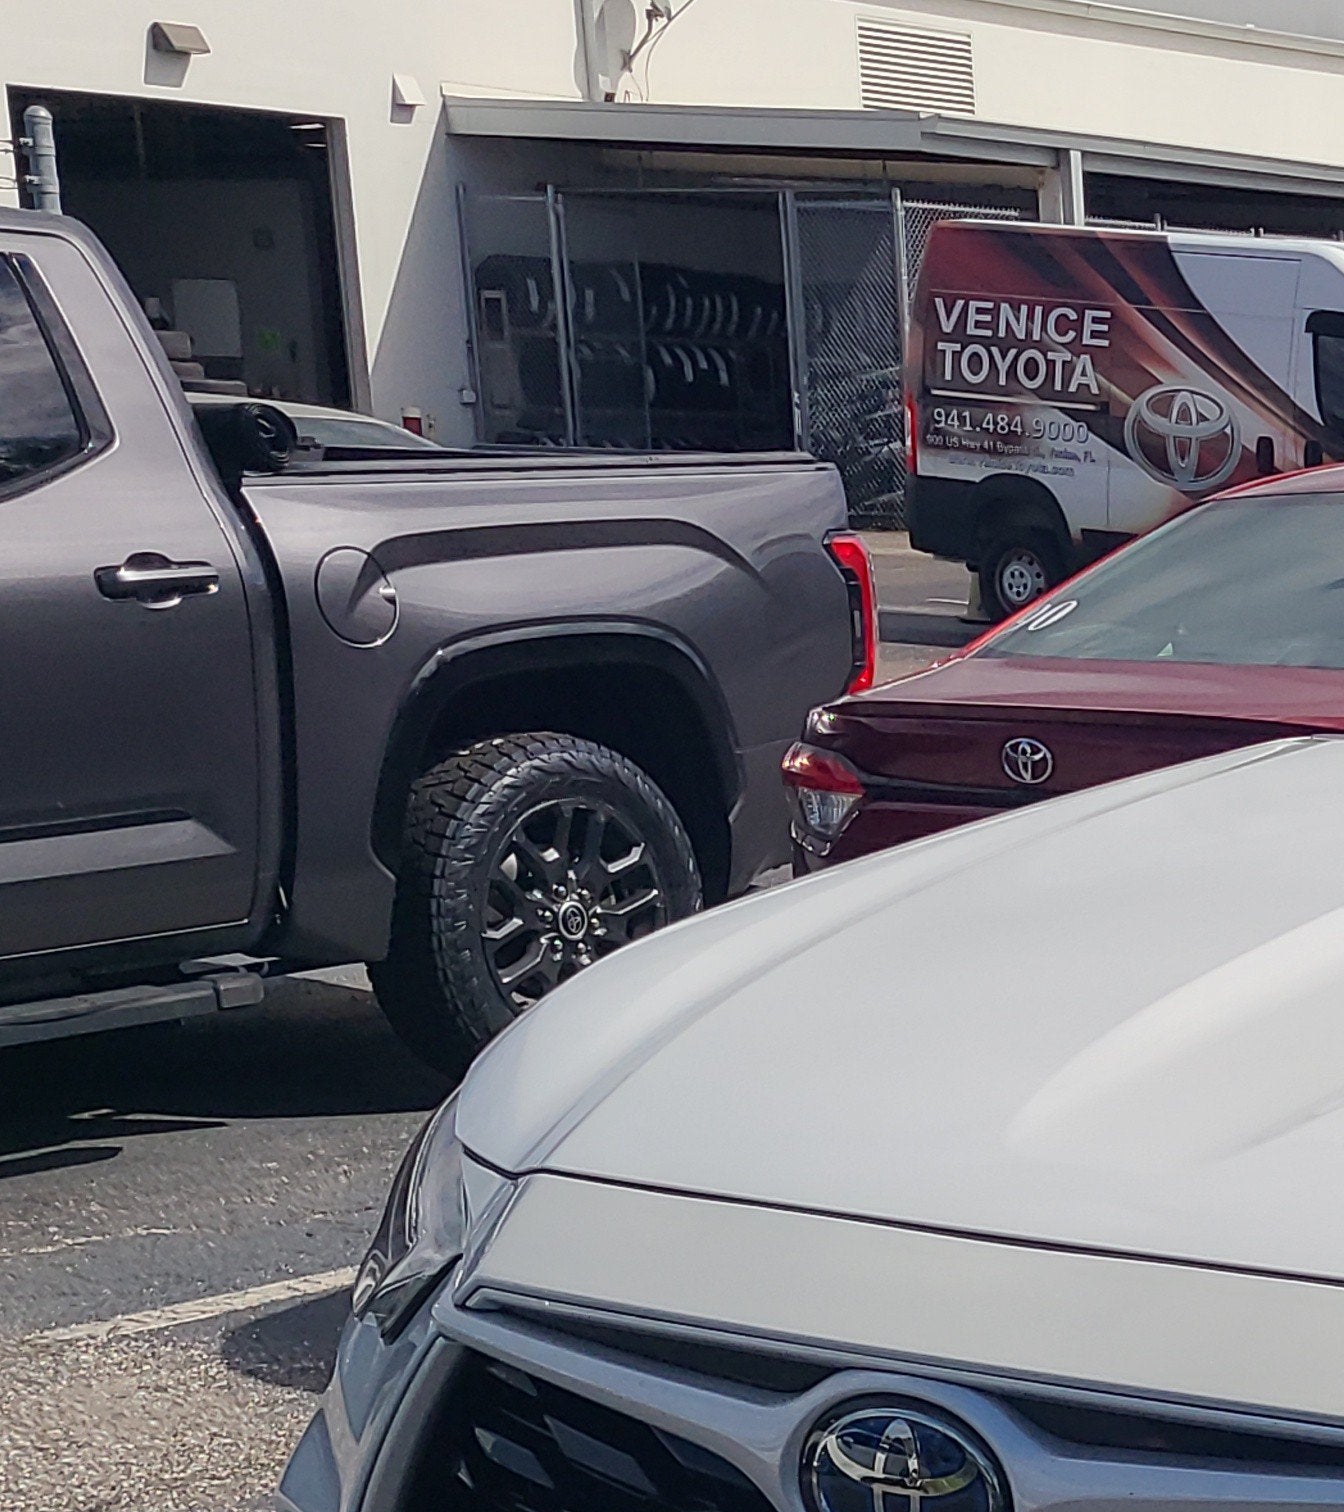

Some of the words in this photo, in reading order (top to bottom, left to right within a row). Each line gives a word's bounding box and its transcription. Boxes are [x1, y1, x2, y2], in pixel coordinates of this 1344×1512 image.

[934, 297, 1112, 347] VENICE
[936, 341, 1100, 395] TOYOTA
[933, 407, 1090, 444] 941.484.9000
